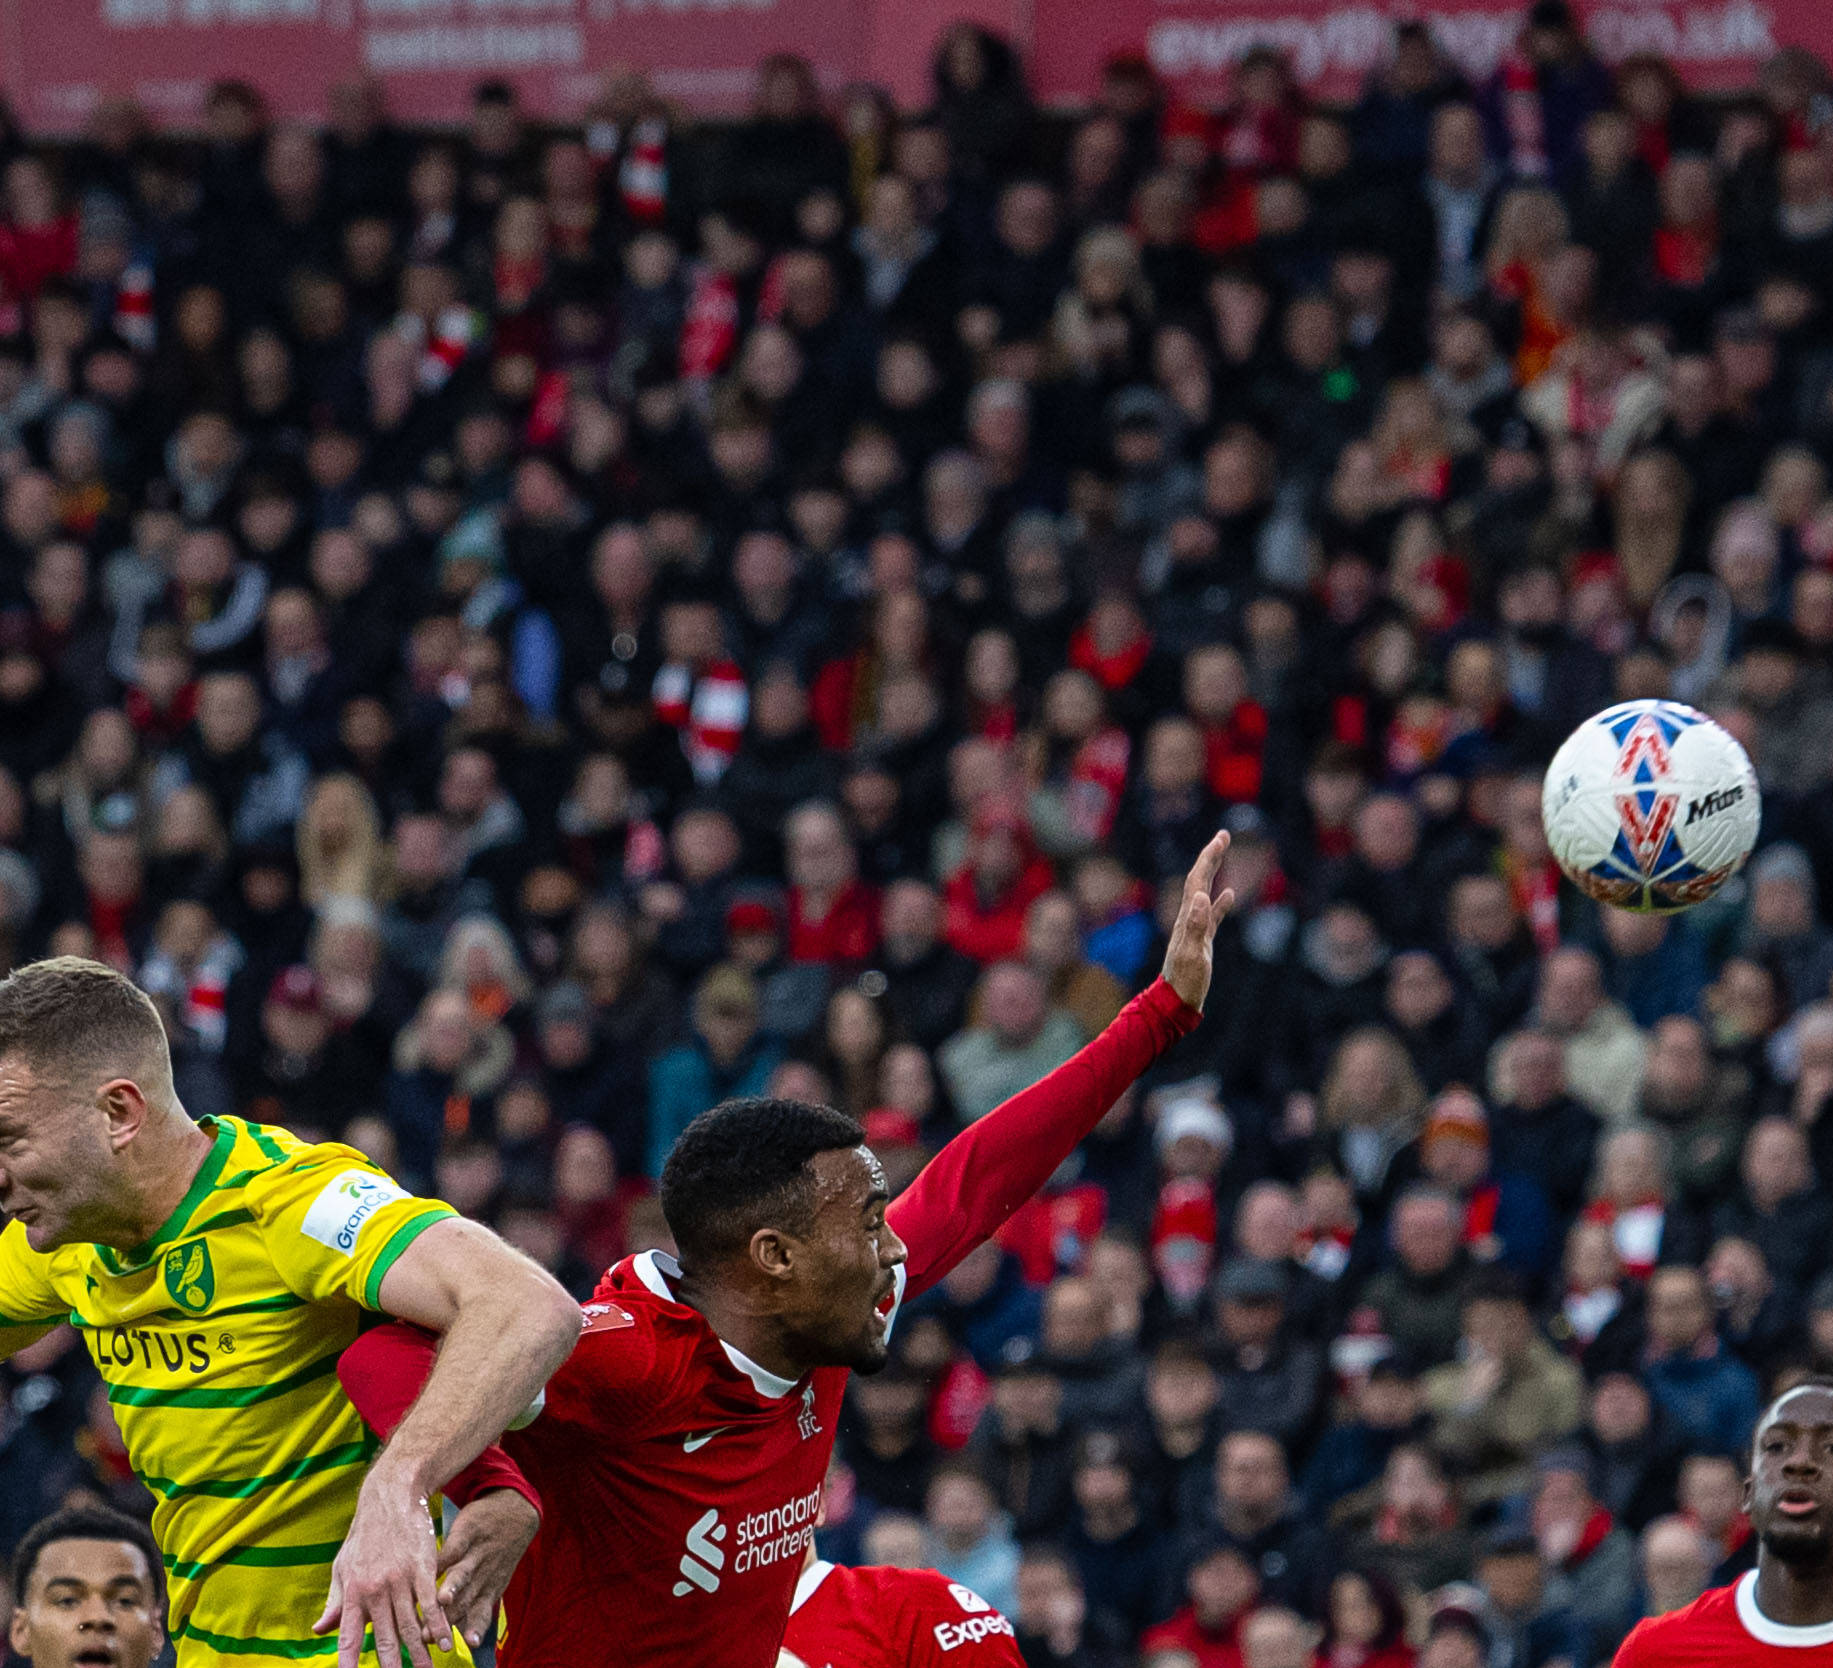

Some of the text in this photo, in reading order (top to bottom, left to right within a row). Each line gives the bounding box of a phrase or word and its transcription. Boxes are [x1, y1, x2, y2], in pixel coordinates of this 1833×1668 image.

[96, 1326, 211, 1374] LOTUS
[736, 1482, 821, 1546] standard
[734, 1523, 814, 1574] chartere
